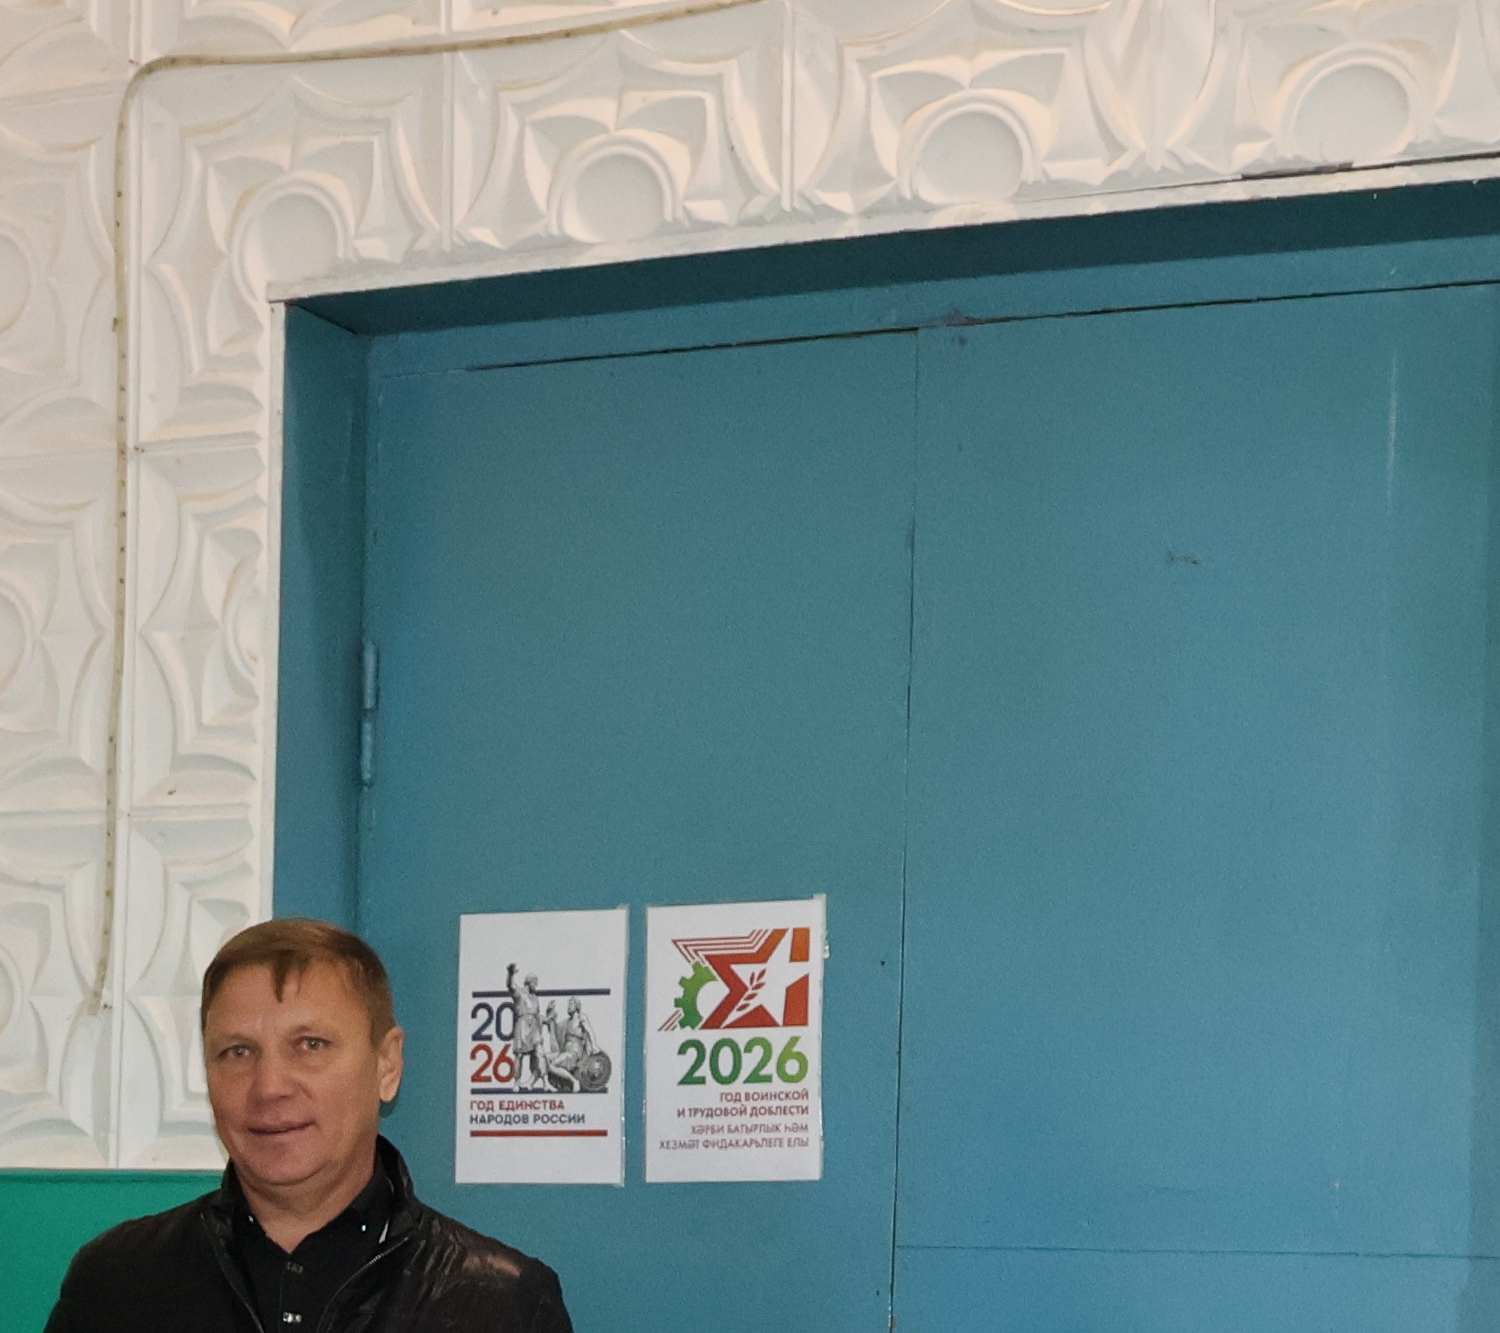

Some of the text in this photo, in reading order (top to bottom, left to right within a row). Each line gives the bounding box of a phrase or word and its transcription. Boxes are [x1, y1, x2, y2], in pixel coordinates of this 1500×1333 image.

[471, 1002, 515, 1041] 20
[470, 1043, 515, 1083] 26
[677, 1035, 809, 1086] 2026
[720, 1088, 809, 1103] ГОД ВОИНСКОЙ
[470, 1100, 565, 1112] ГОД ЕДИНСТВА
[677, 1104, 809, 1119] И ТРУДОВОЙ ДОБЛЕСТИ
[470, 1114, 586, 1125] НАРОДОВ РОССИИ
